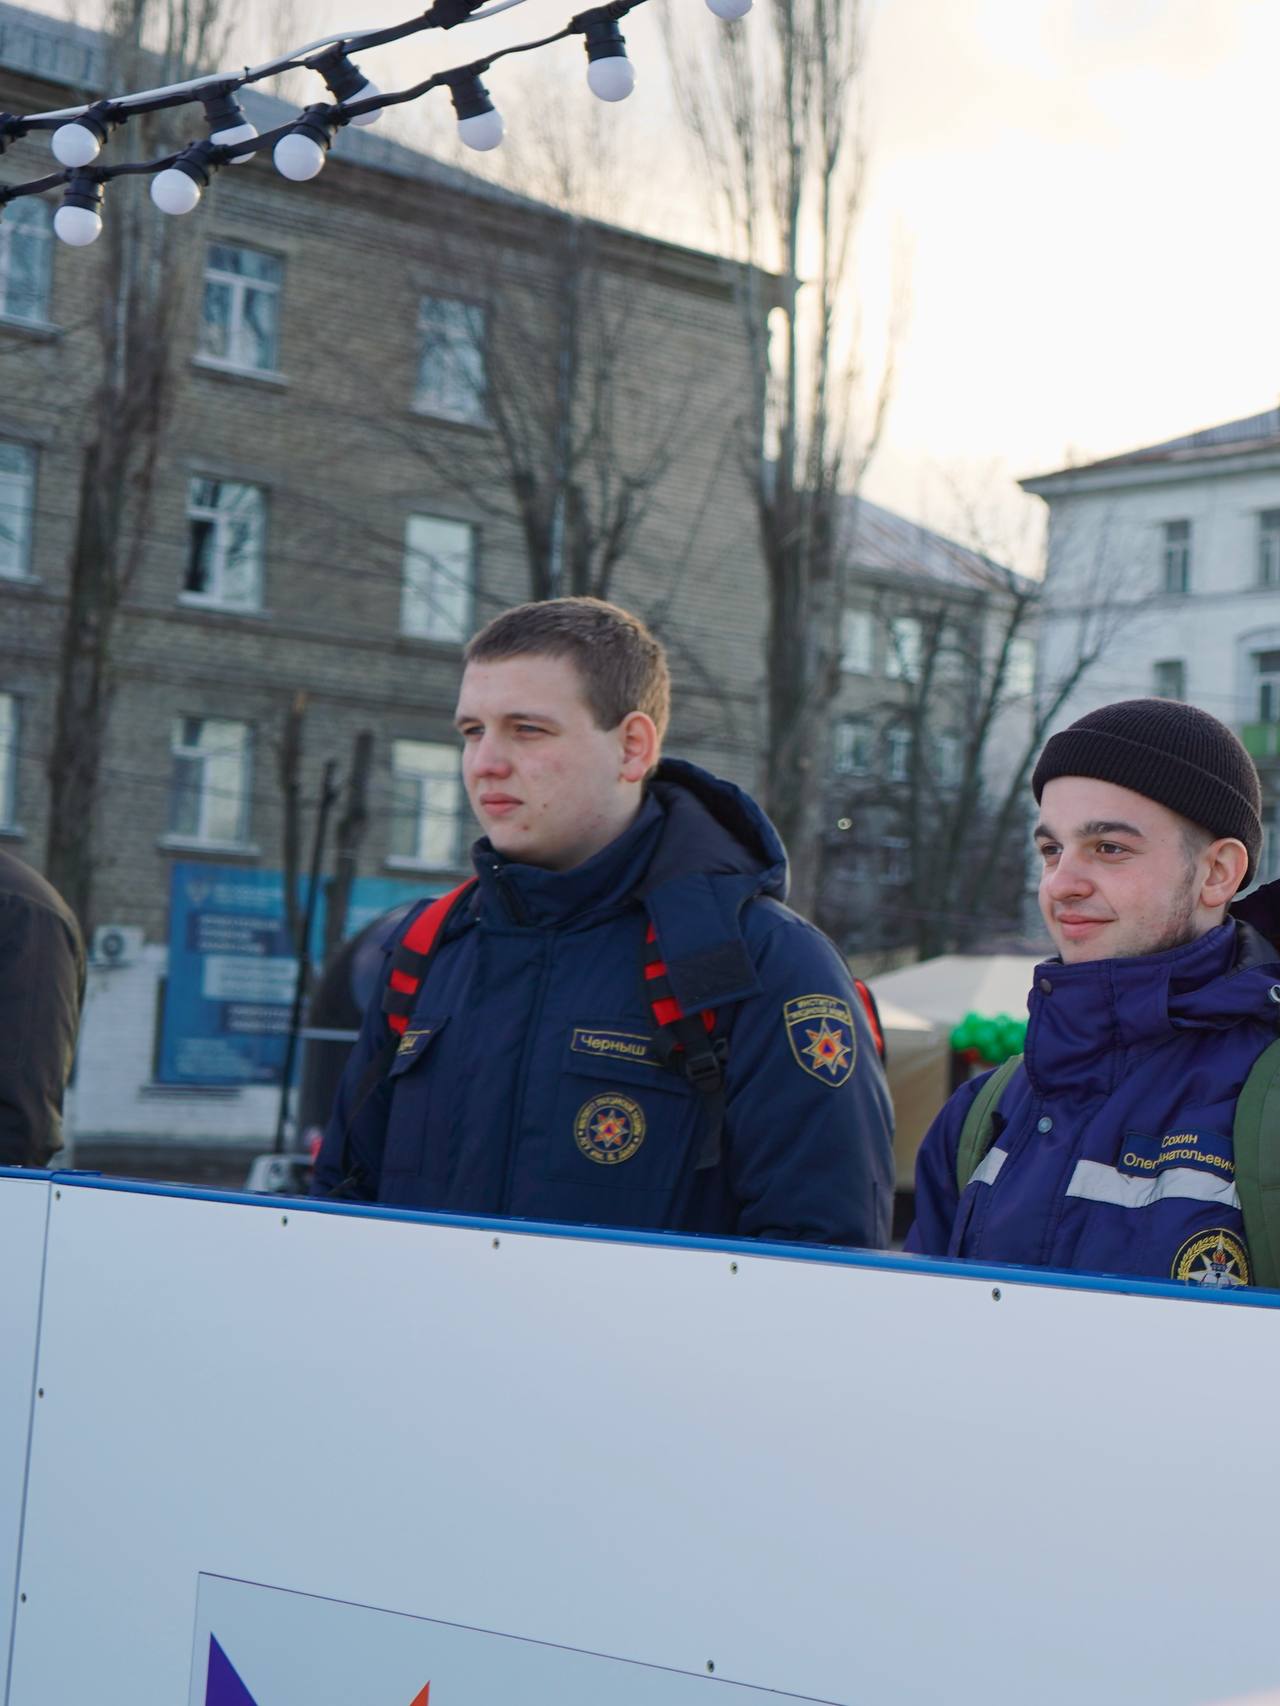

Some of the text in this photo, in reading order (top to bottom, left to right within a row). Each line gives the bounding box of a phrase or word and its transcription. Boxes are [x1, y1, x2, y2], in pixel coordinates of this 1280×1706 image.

[580, 1034, 647, 1056] Черныш
[1161, 1133, 1199, 1148] Сохин
[1122, 1152, 1160, 1170] Олег
